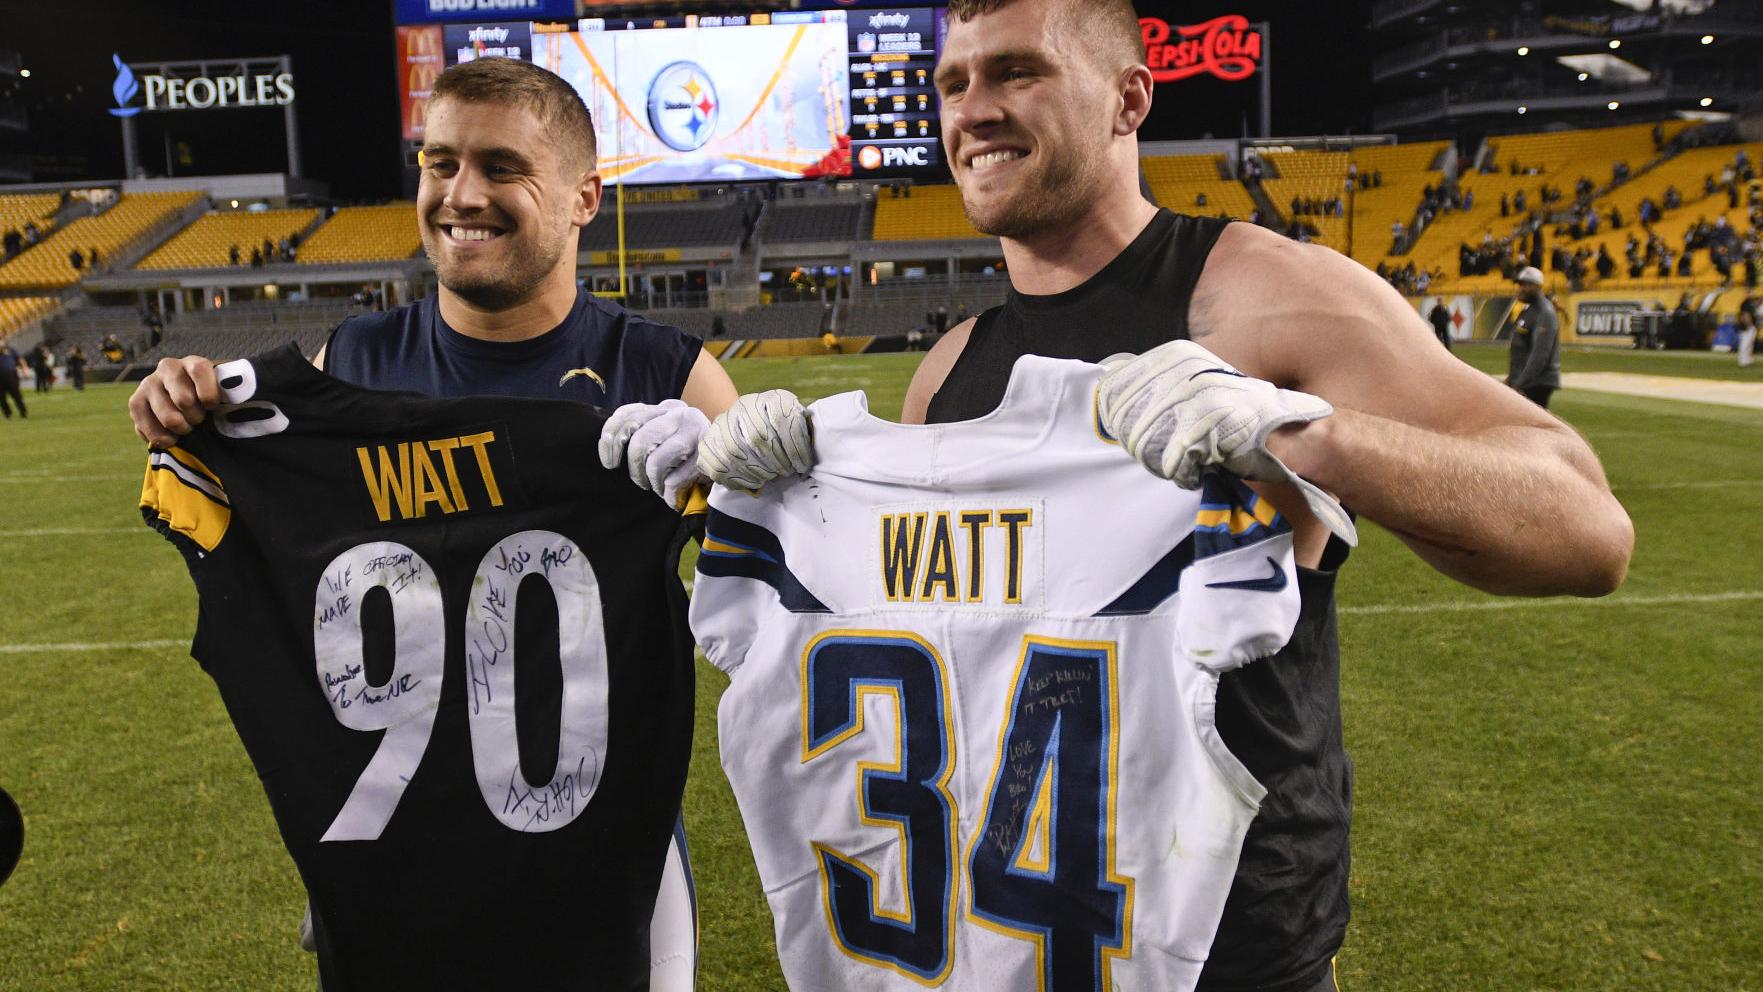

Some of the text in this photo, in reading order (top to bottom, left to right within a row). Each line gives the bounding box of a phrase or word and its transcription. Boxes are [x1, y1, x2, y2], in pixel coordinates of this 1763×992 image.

[469, 26, 509, 43] xfinity
[869, 12, 910, 29] xfinity
[881, 146, 928, 167] PNC
[1578, 313, 1632, 334] UNITE
[356, 431, 504, 522] WATT
[880, 508, 1033, 604] WATT
[314, 529, 609, 842] 90
[800, 629, 1135, 992] 34
